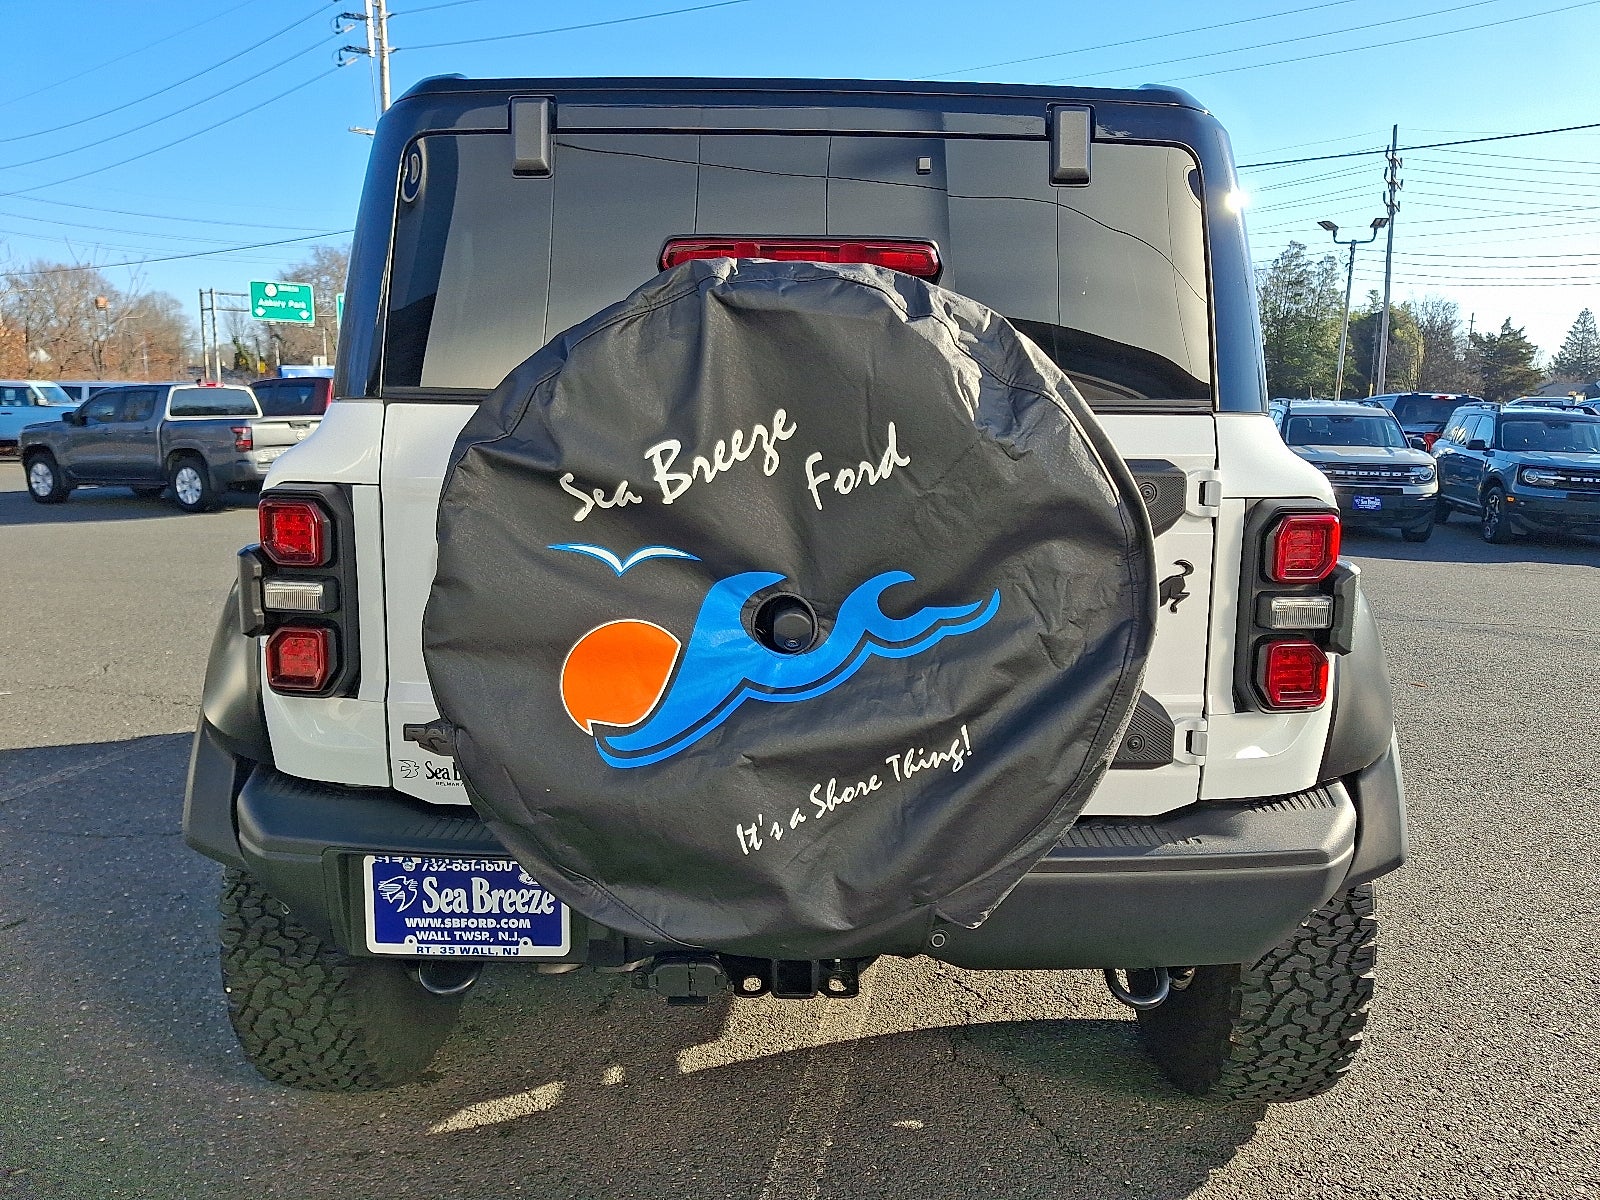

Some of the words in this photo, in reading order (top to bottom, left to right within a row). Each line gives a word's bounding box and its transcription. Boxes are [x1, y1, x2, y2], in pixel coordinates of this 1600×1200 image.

[559, 472, 642, 522] Sea
[644, 408, 798, 504] Breeze
[805, 421, 911, 510] Ford
[425, 760, 451, 781] Sea
[736, 814, 784, 856] It's
[790, 808, 807, 830] a
[810, 774, 883, 819] Shore
[885, 724, 973, 782] Thing!
[422, 876, 469, 914] Sea
[470, 876, 556, 915] Breeze
[404, 917, 532, 929] WWW.SBFORD.COM
[415, 930, 452, 941] WALL
[416, 946, 437, 954] RT.
[440, 946, 456, 955] 35
[459, 947, 499, 956] WALL,
[502, 947, 519, 956] NJ
